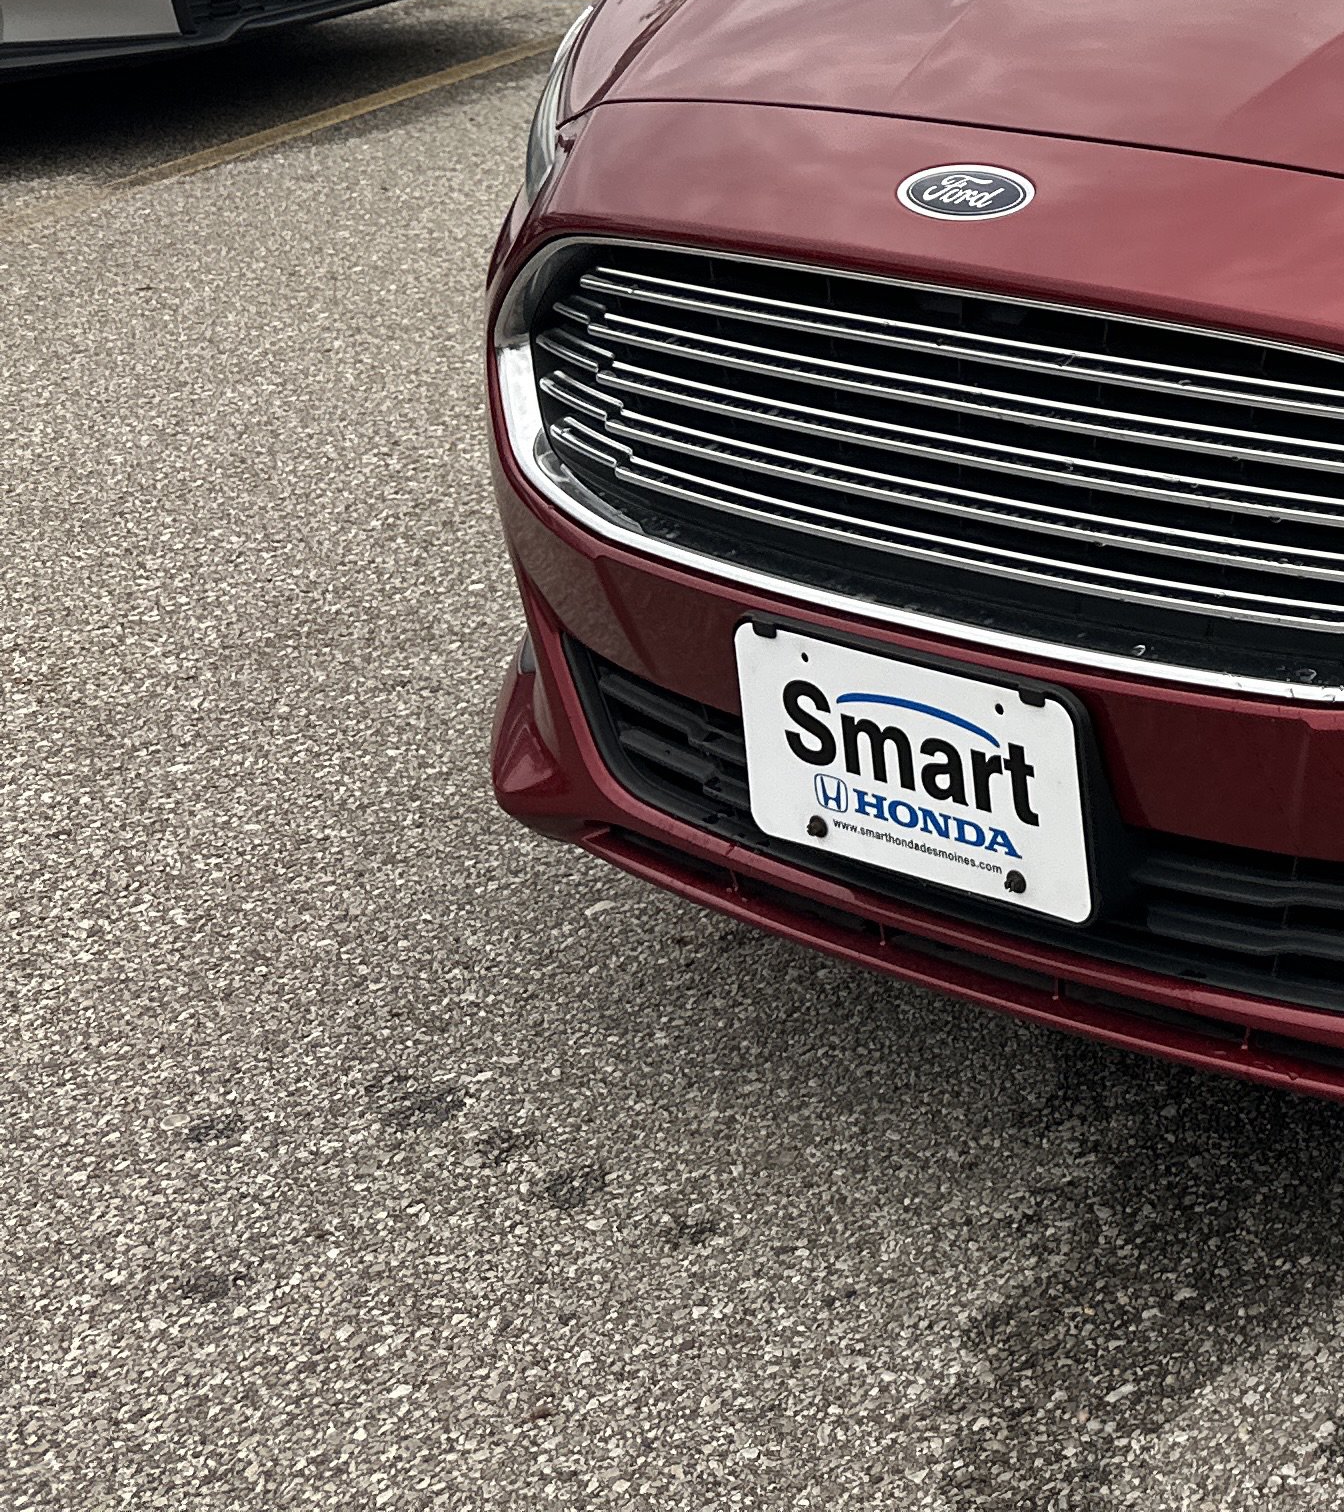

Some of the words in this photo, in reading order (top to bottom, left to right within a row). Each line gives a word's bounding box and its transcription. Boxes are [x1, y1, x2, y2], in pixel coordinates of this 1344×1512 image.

[922, 174, 1006, 209] Ford
[782, 679, 1040, 828] Smart
[832, 818, 1003, 875] www.smarthondadesmoines.com
[852, 787, 1023, 860] HONDA
